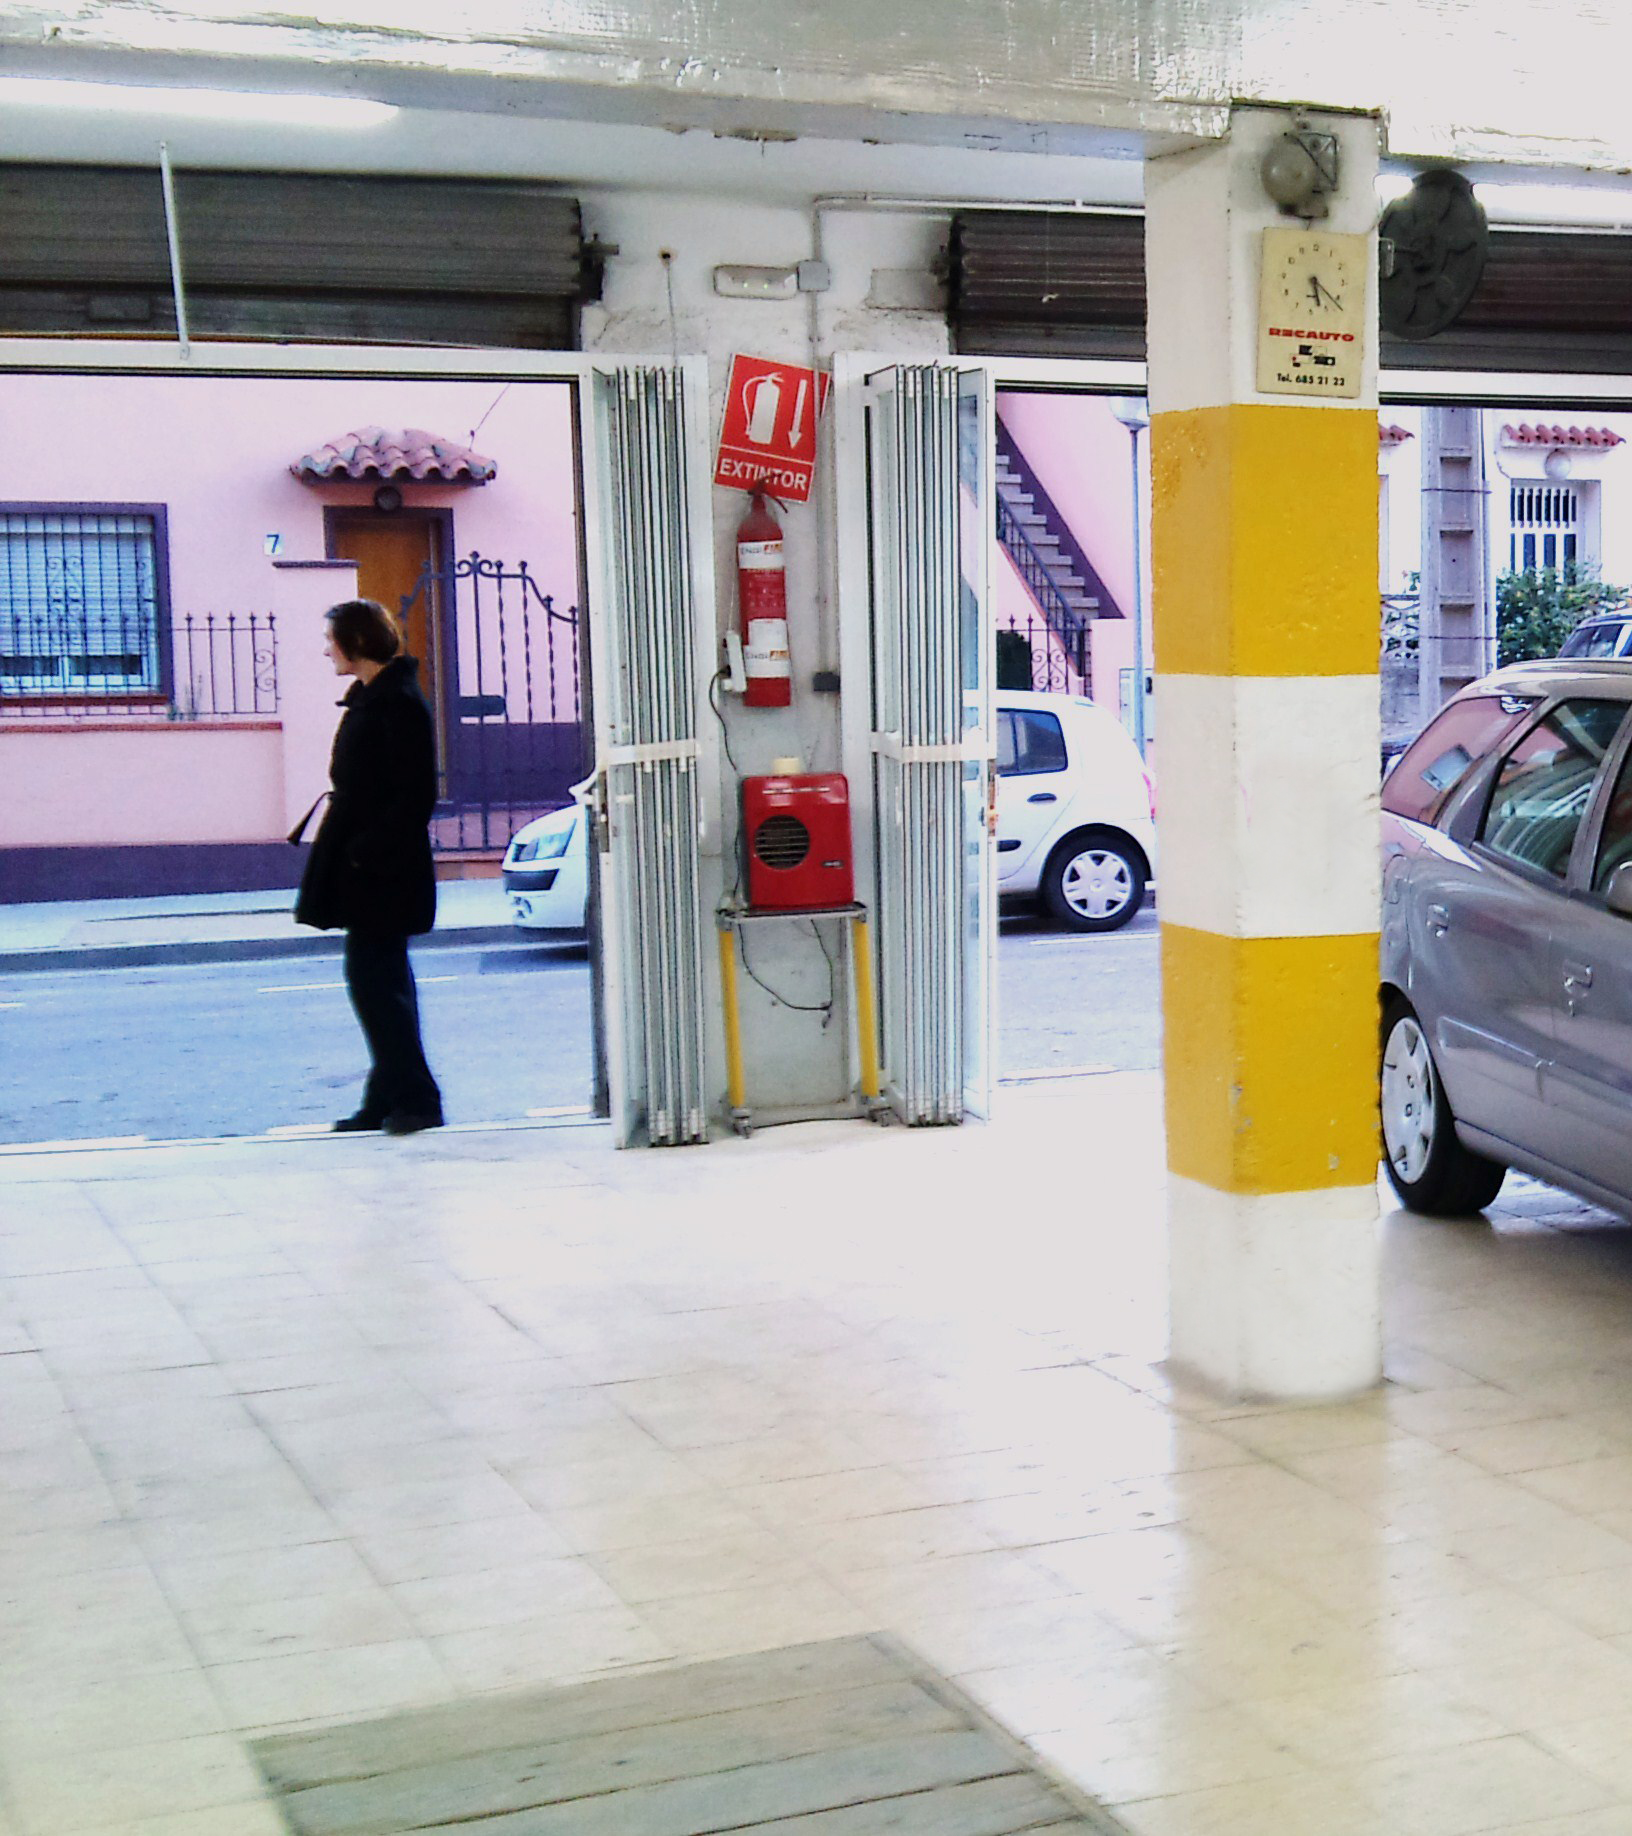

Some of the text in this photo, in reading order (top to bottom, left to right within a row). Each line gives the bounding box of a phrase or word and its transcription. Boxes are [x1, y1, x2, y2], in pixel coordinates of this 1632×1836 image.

[1268, 326, 1355, 342] RECAUTO
[719, 457, 808, 491] EXTINTOR
[266, 533, 280, 554] 7
